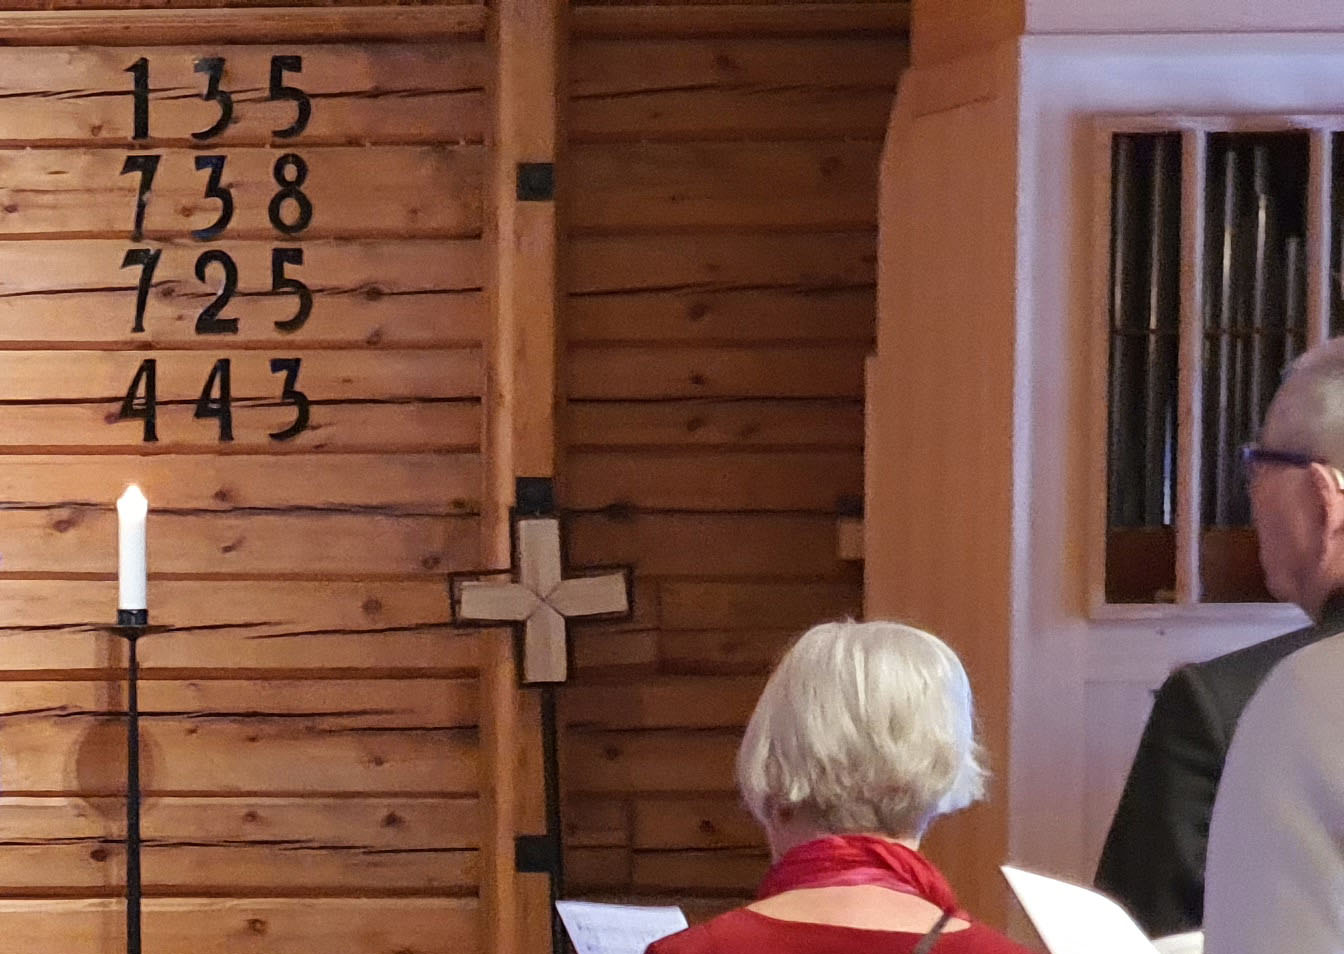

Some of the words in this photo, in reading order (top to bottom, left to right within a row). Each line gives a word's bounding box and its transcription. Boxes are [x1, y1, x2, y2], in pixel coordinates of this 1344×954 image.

[123, 55, 312, 140] 135
[119, 153, 313, 242] 738
[120, 247, 313, 335] 725
[118, 357, 310, 442] 443
